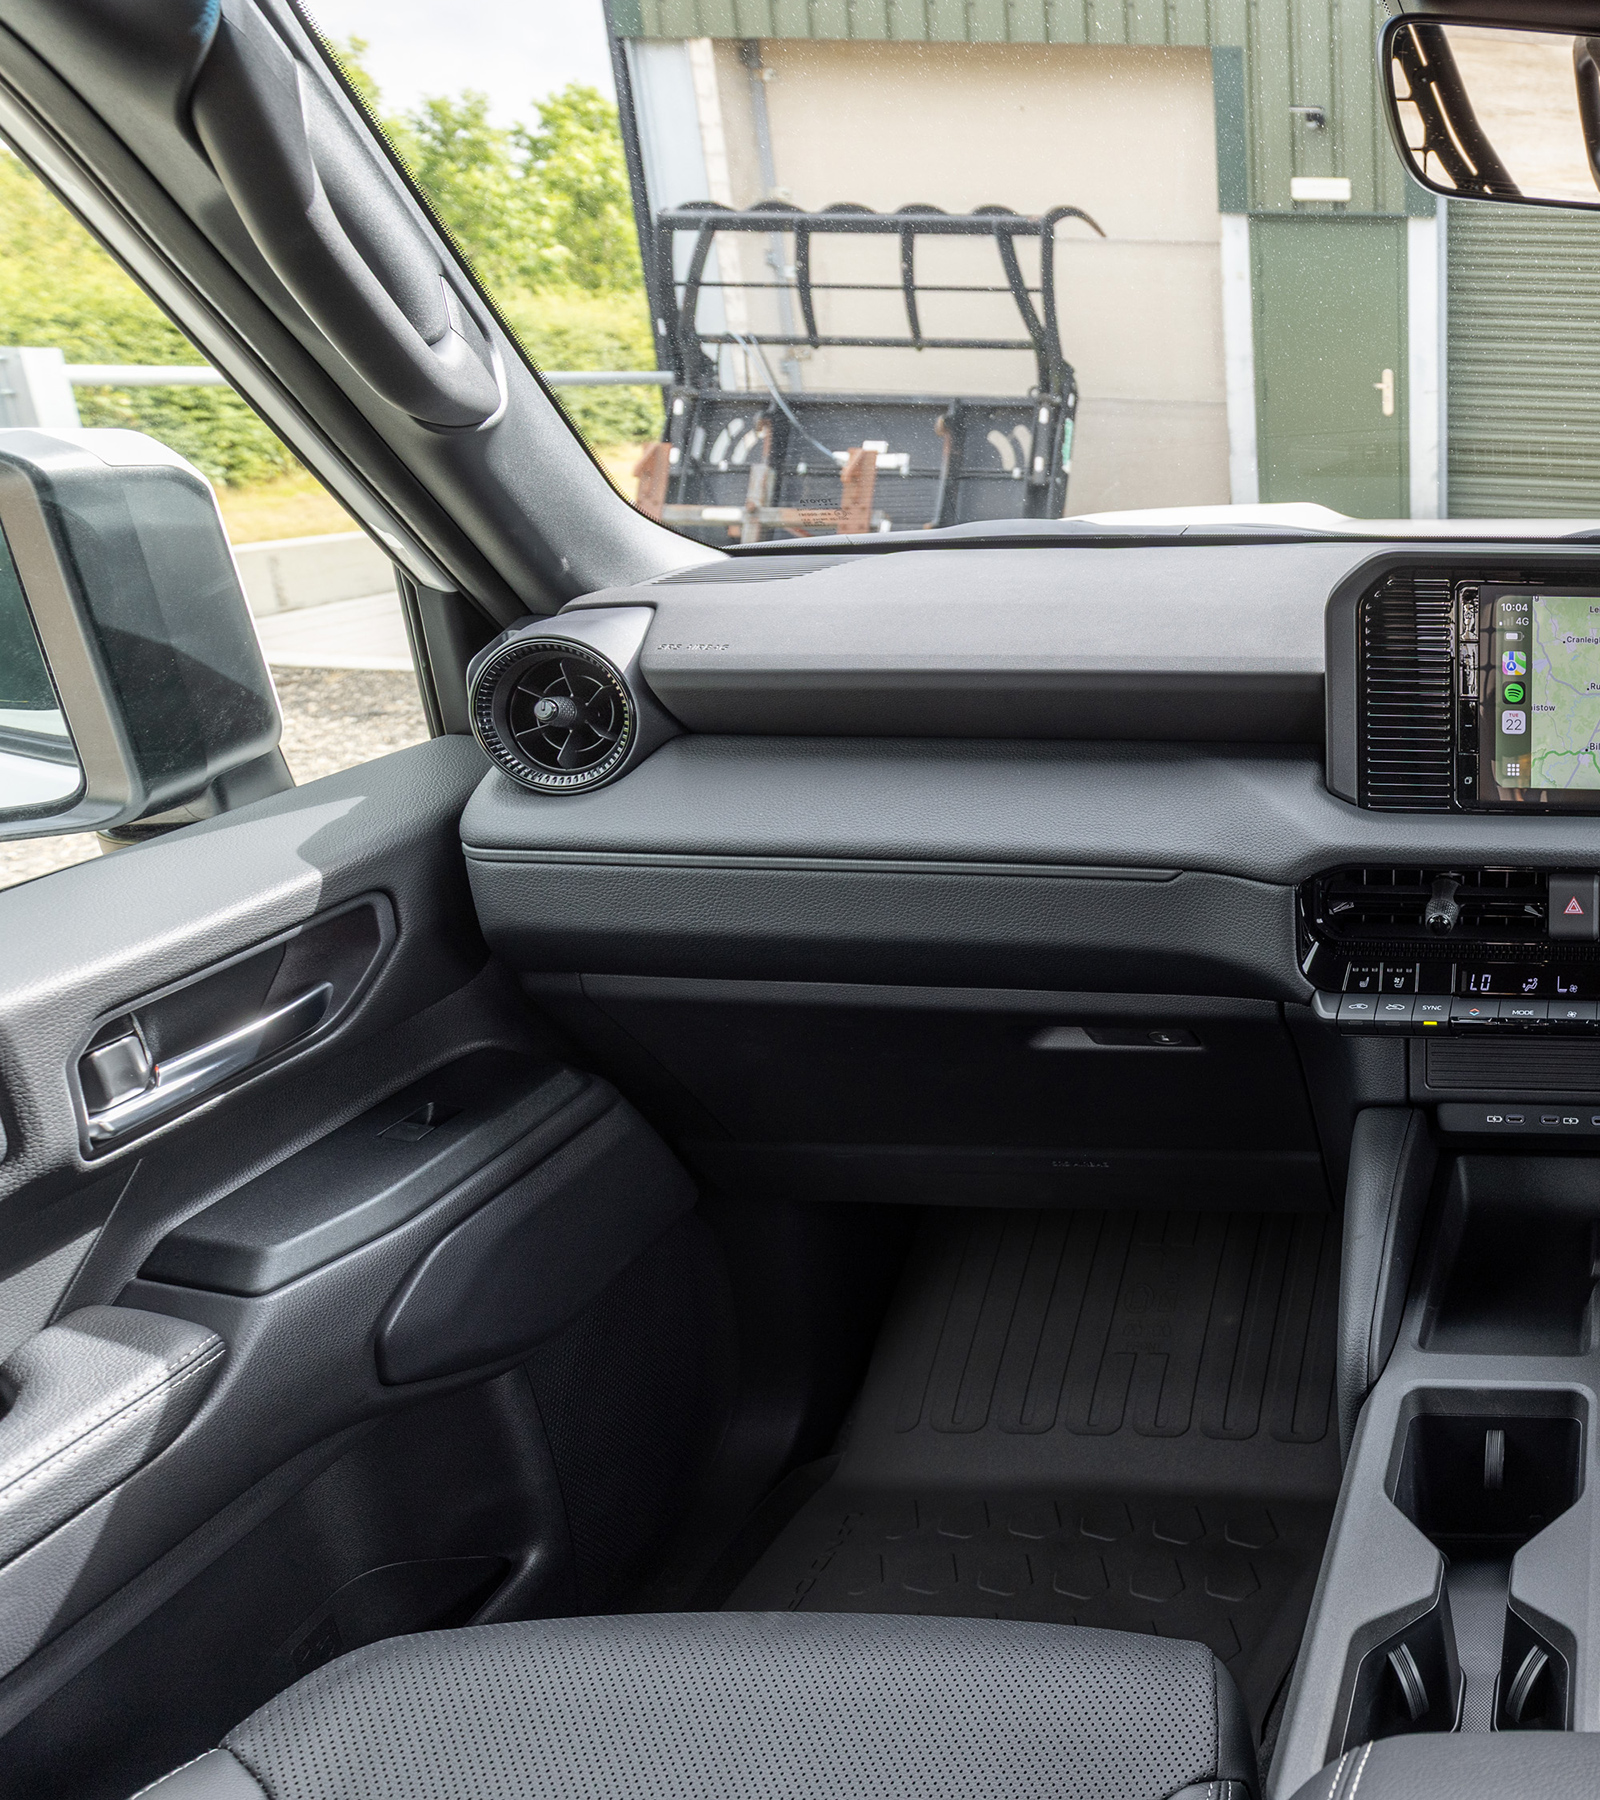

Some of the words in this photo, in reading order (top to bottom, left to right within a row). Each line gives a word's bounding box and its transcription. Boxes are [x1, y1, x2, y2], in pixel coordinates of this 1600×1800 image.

[1501, 603, 1528, 611] 10:04
[1506, 719, 1522, 731] 22
[1470, 974, 1491, 991] LO
